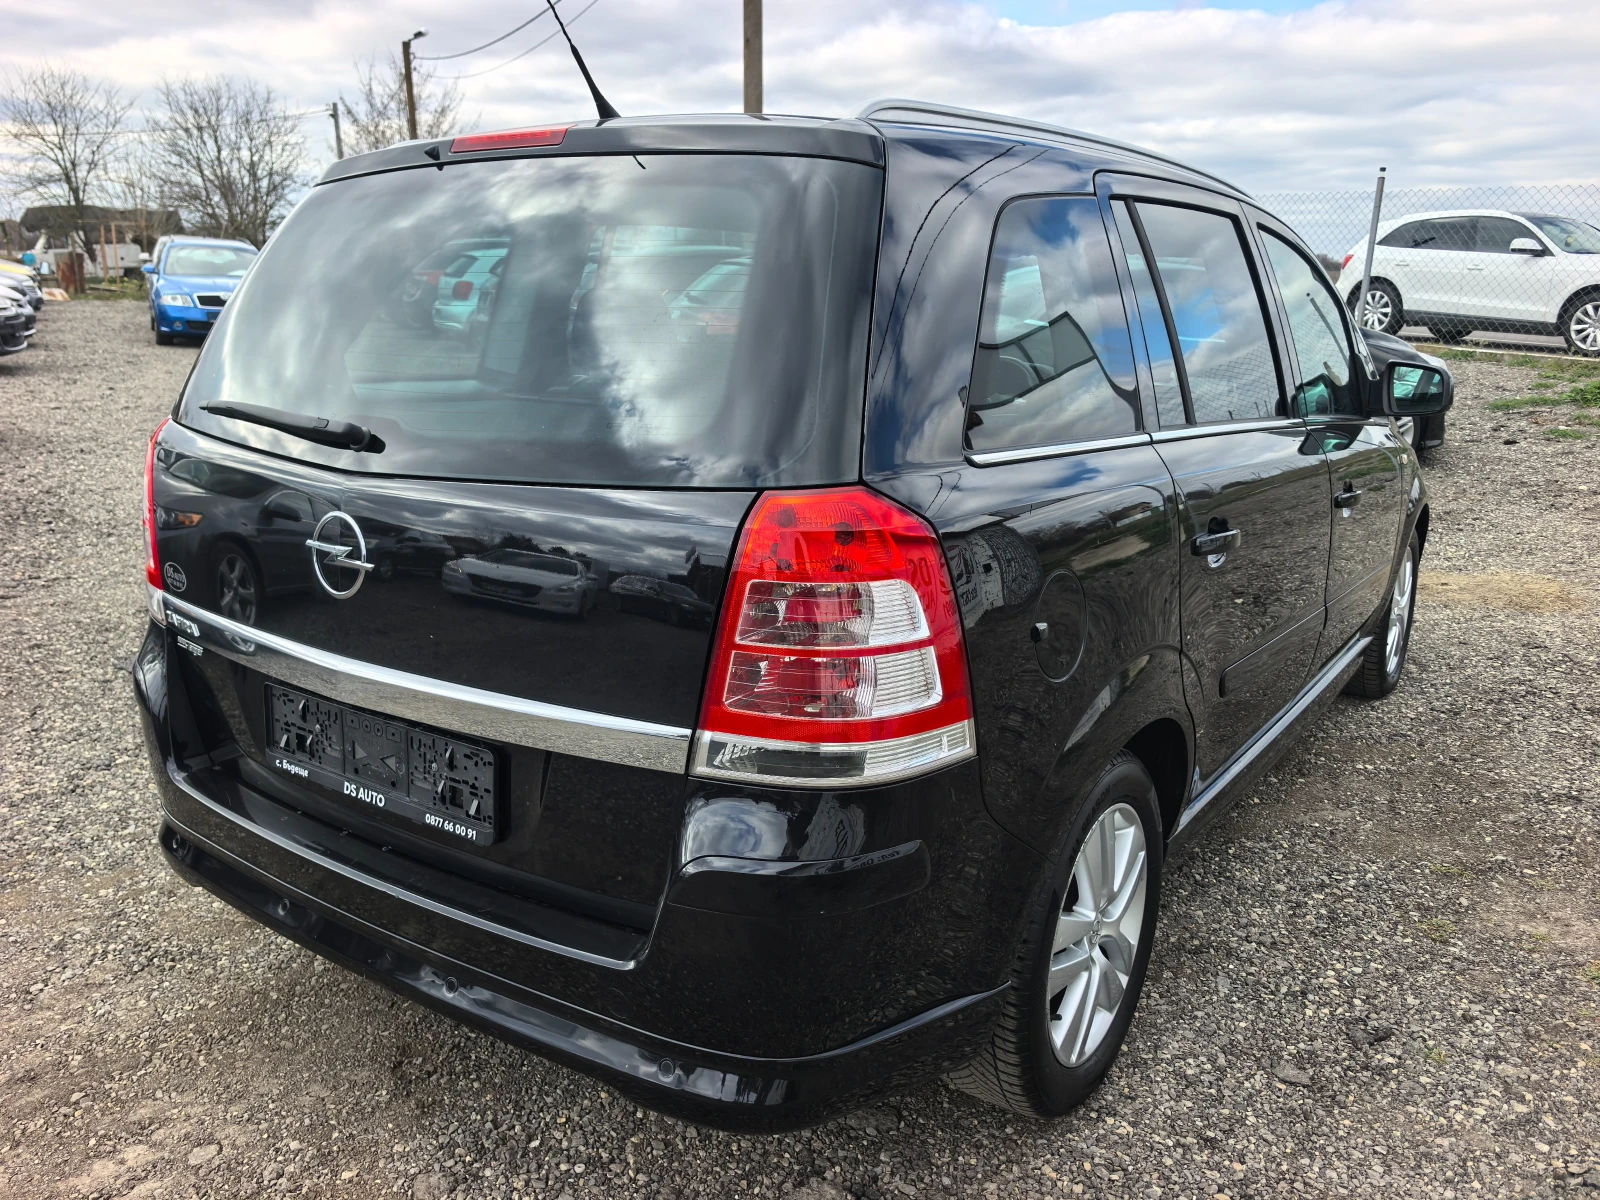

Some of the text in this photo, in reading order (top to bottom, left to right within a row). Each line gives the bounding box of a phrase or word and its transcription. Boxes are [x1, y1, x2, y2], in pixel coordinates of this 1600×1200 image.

[282, 759, 309, 778] Бъдеще
[343, 781, 385, 808] DS AUTO
[425, 813, 477, 841] 0877 66 00 91
